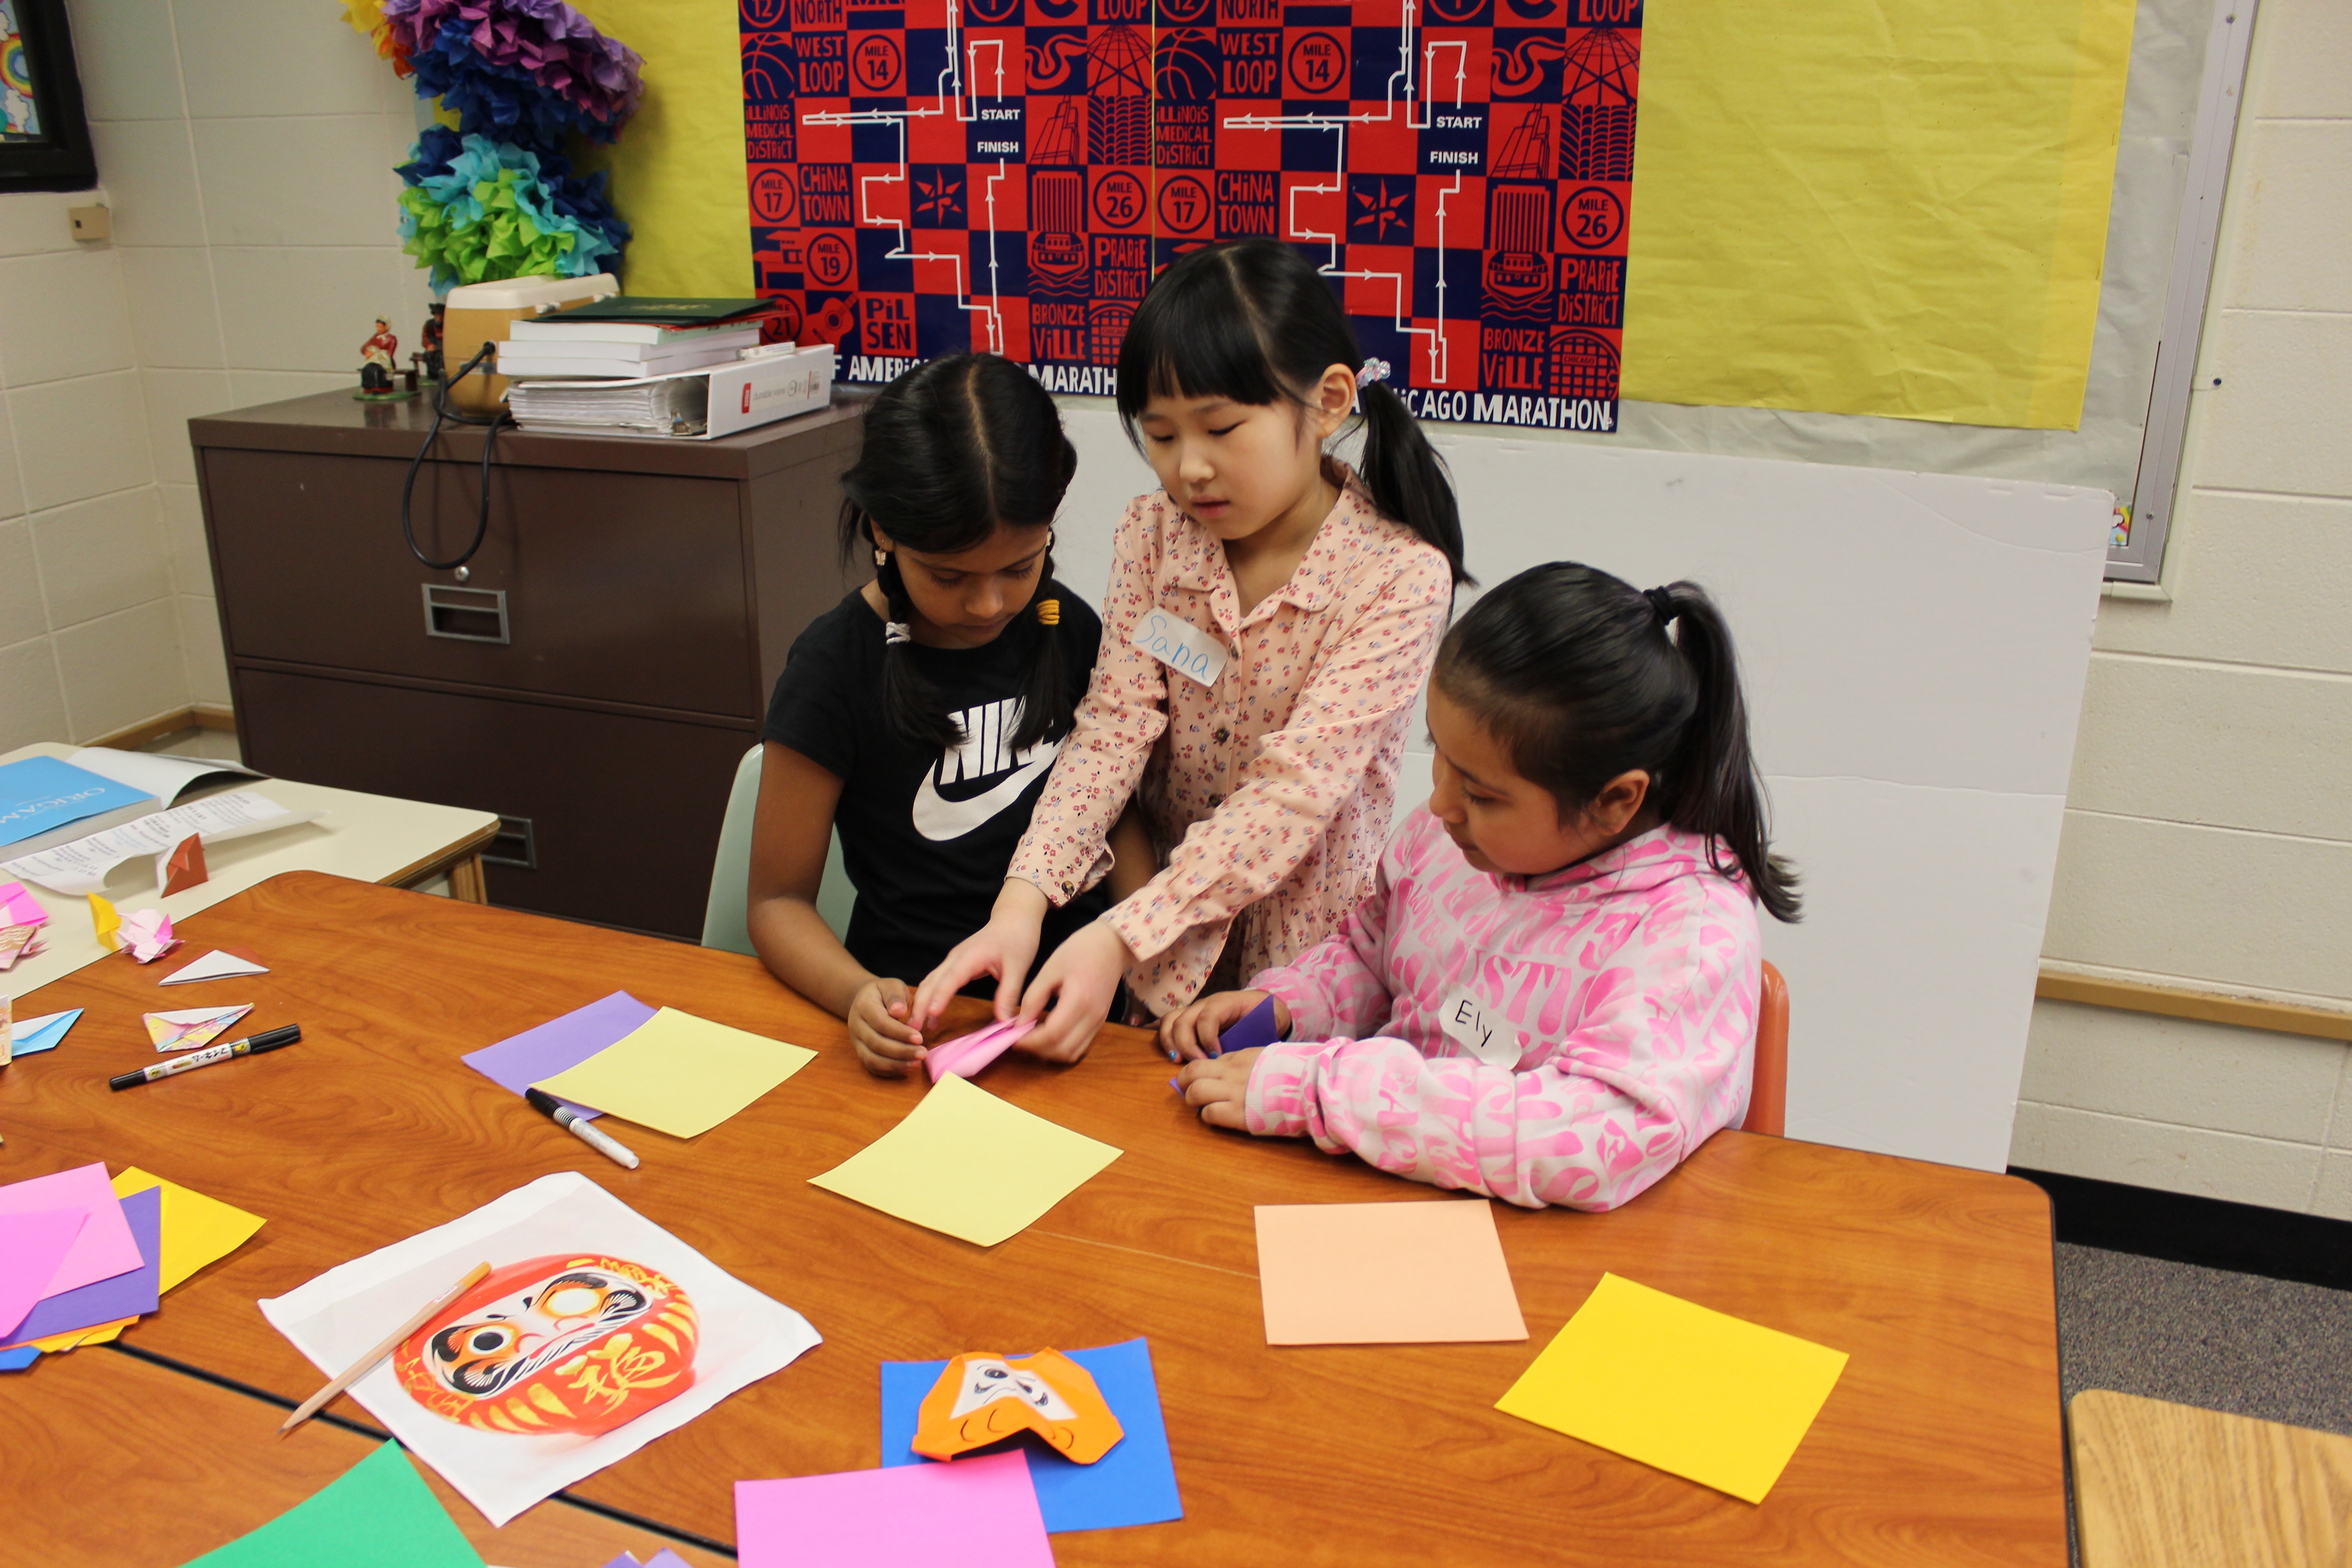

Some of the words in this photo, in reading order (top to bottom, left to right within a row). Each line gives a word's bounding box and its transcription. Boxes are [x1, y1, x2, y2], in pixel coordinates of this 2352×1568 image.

[794, 0, 842, 24] NORTH
[794, 36, 844, 57] WEST
[864, 45, 889, 56] MILE
[1220, 33, 1279, 56] WEST
[1303, 44, 1331, 56] MILE
[799, 60, 844, 93] LOOP
[867, 59, 889, 81] 14
[1223, 60, 1277, 94] LOOP
[1305, 59, 1330, 82] 14
[981, 109, 1021, 120] START
[1436, 116, 1482, 129] START
[977, 142, 1019, 153] FINISH
[1430, 151, 1478, 165] FINISH
[761, 179, 783, 189] MILE
[1106, 181, 1132, 194] MILE
[1171, 187, 1197, 198] MILE
[763, 193, 782, 212] 17
[802, 194, 850, 221] TOWN
[1106, 196, 1133, 218] 26
[1173, 201, 1195, 223] 17
[1578, 198, 1609, 211] MILE
[1218, 204, 1275, 234] TOWN
[1576, 214, 1607, 238] 26
[818, 244, 840, 254] MILE
[820, 257, 841, 276] 19
[1032, 302, 1085, 325] BRONZE
[772, 317, 791, 336] 21
[867, 322, 912, 349] SEN
[1483, 327, 1546, 353] BRONZE
[1028, 364, 1117, 396] MARATH
[1473, 393, 1610, 431] MARATHON
[1135, 615, 1207, 681] Sana
[0, 787, 105, 824] ORIGAM
[1455, 999, 1493, 1048] Ely
